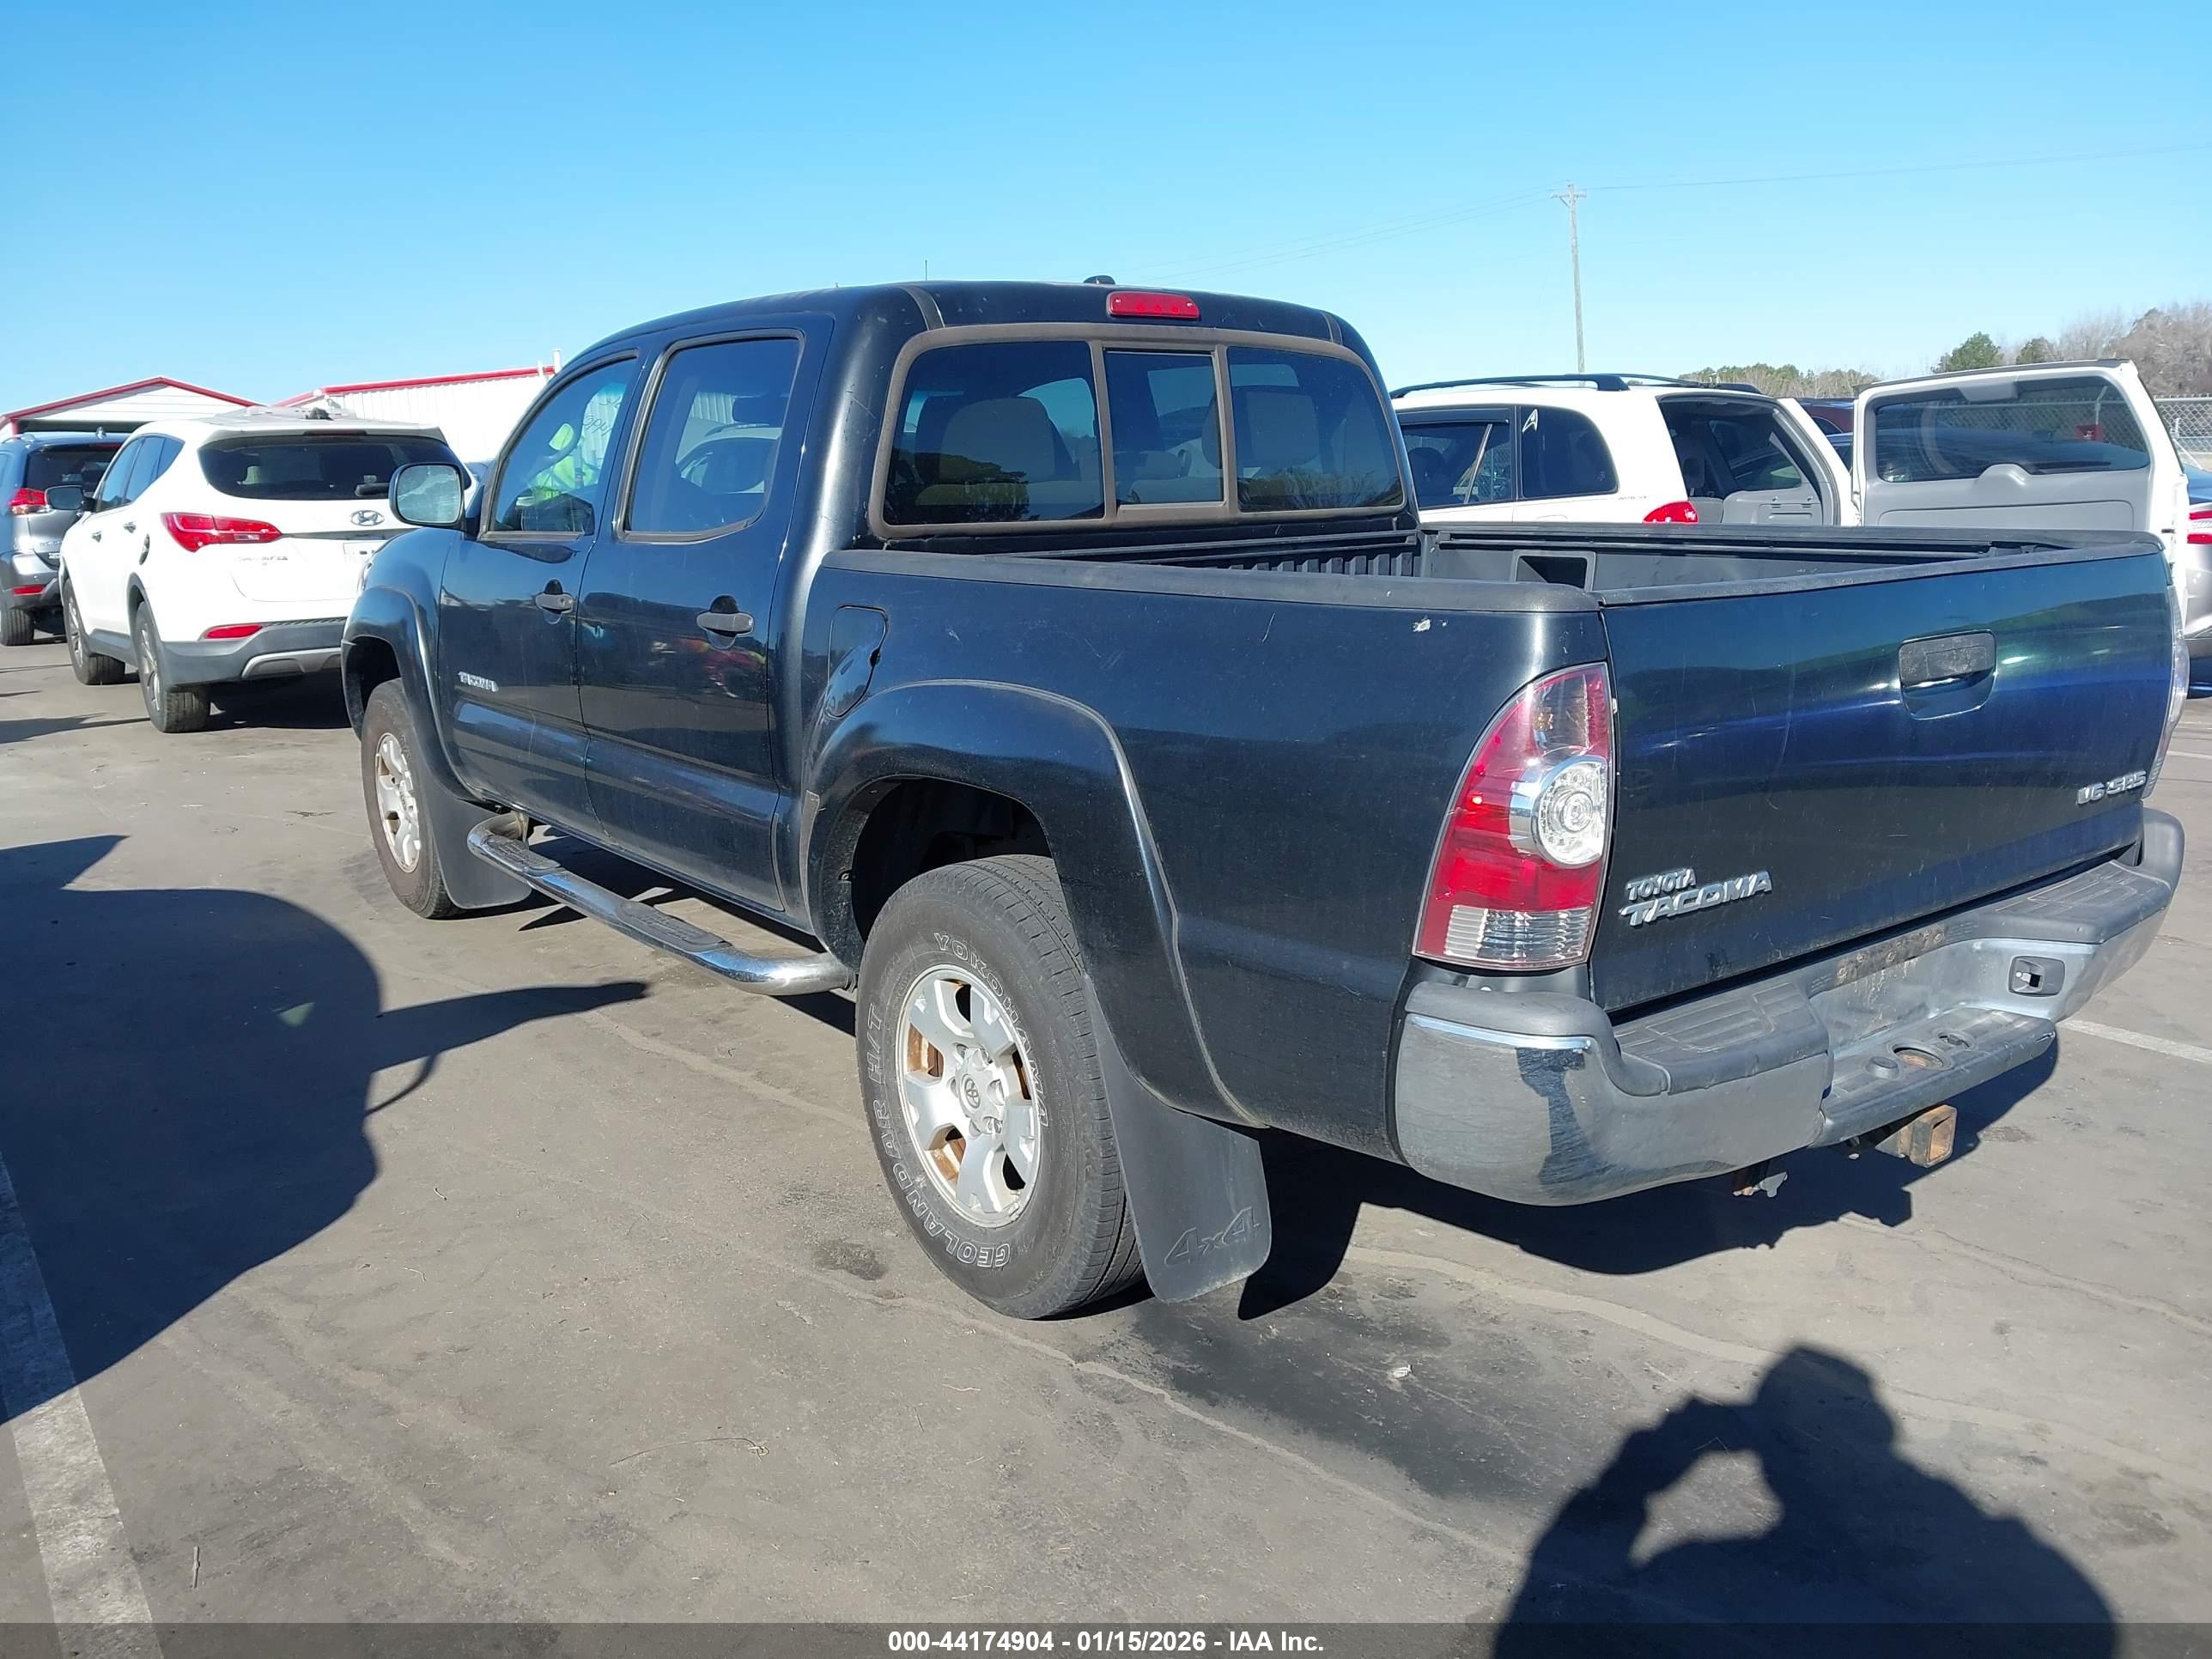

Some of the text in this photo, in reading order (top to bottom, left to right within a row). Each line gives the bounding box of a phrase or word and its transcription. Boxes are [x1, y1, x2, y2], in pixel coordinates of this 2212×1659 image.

[1620, 870, 1773, 927] TACOMA
[1626, 867, 1697, 901] TOYOTA
[933, 932, 1049, 1127] YOKOHAMA
[872, 1098, 1012, 1268] GEOLANDAR
